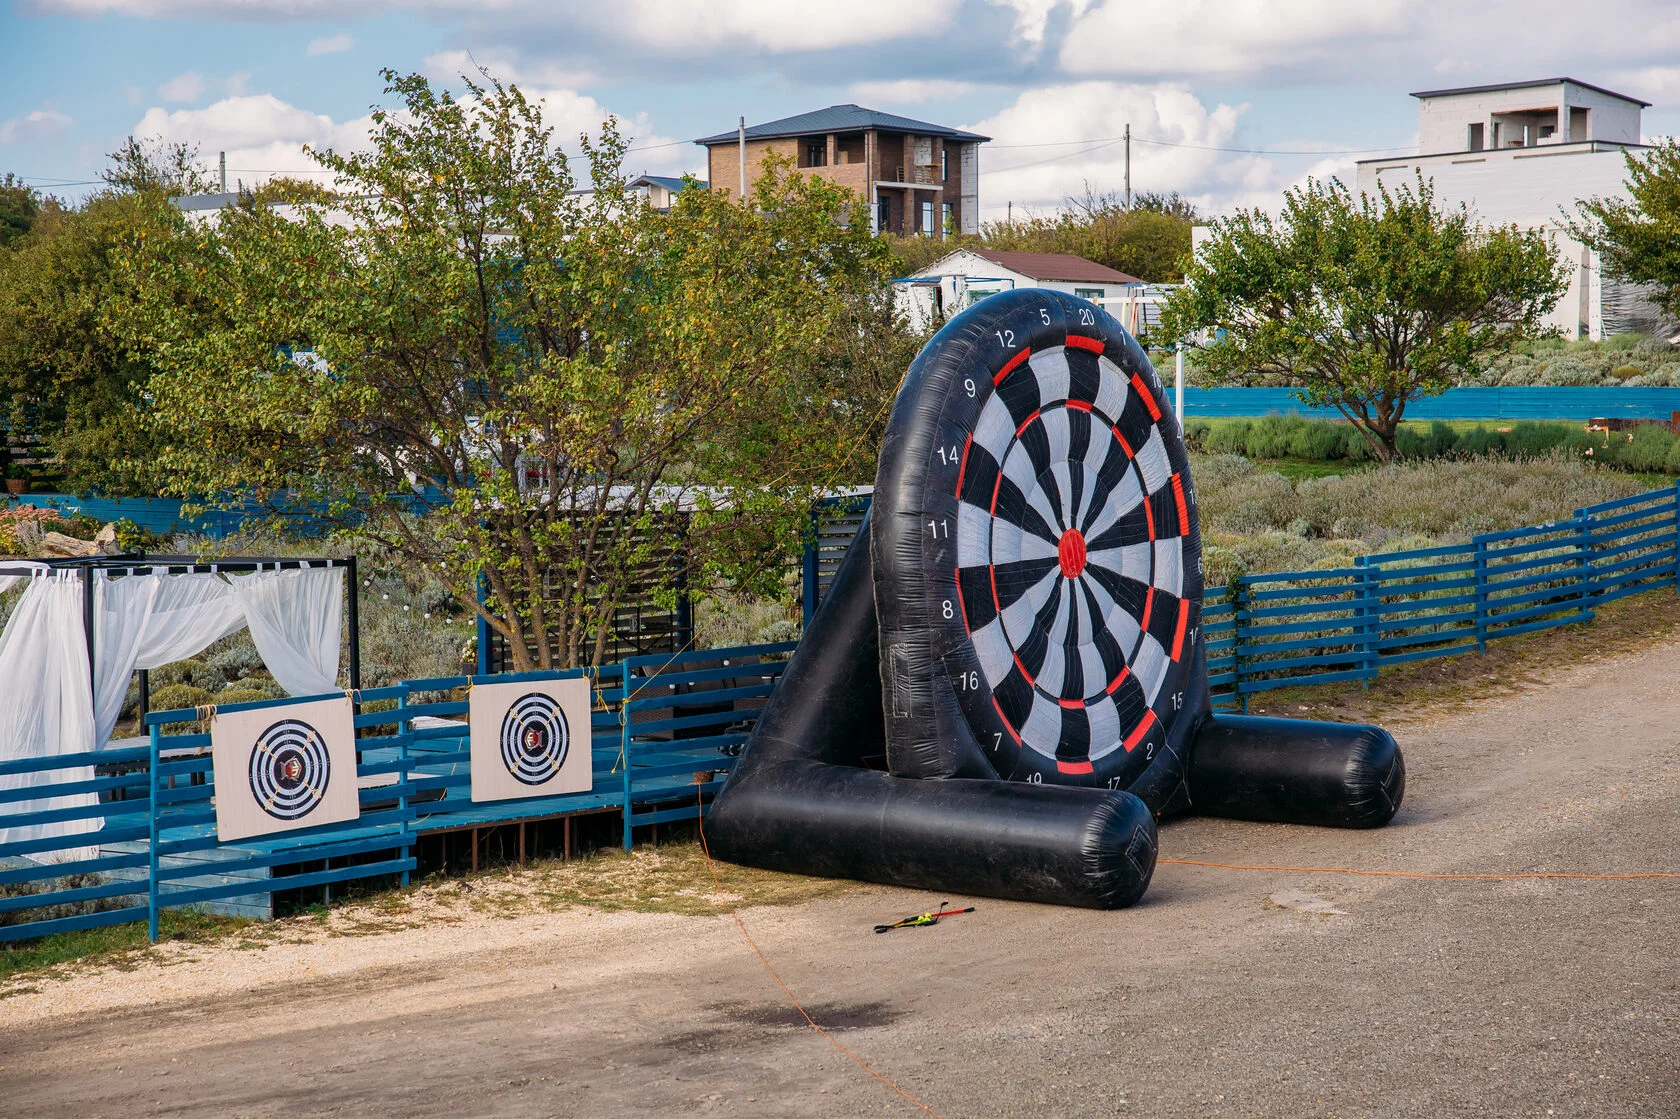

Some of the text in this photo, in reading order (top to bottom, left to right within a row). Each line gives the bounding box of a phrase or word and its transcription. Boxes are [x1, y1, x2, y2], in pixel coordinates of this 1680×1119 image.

[1040, 308, 1051, 326] 5
[1079, 308, 1095, 326] 20
[995, 330, 1016, 348] 12
[1120, 329, 1127, 346] 1
[964, 378, 976, 398] 9
[937, 445, 959, 466] 14
[928, 519, 948, 539] 11
[942, 600, 953, 619] 8
[959, 670, 978, 690] 16
[1171, 692, 1183, 711] 15
[993, 732, 1002, 751] 7
[1146, 742, 1154, 760] 2
[1107, 776, 1120, 791] 17
